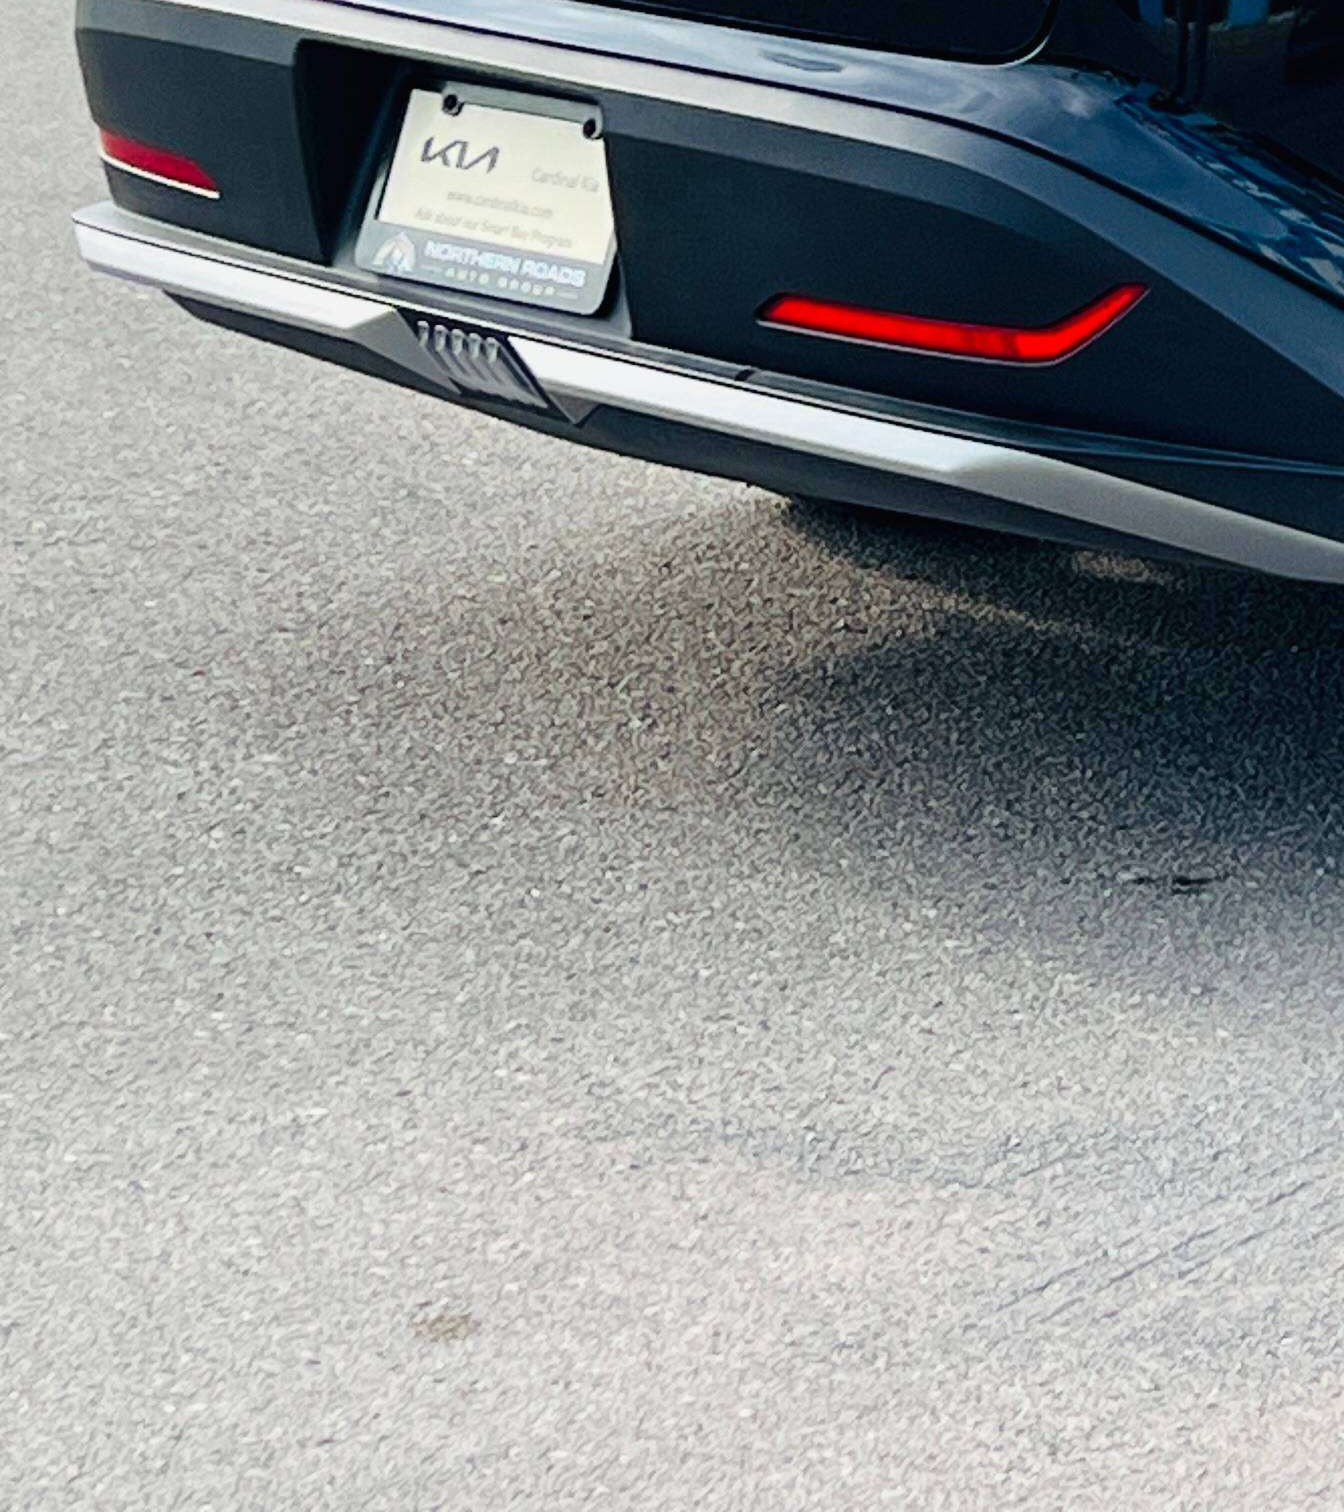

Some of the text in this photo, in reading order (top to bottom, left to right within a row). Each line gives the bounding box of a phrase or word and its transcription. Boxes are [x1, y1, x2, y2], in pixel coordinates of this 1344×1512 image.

[419, 136, 500, 174] KIA
[425, 240, 522, 275] NORTHERN
[522, 257, 587, 289] ROADS
